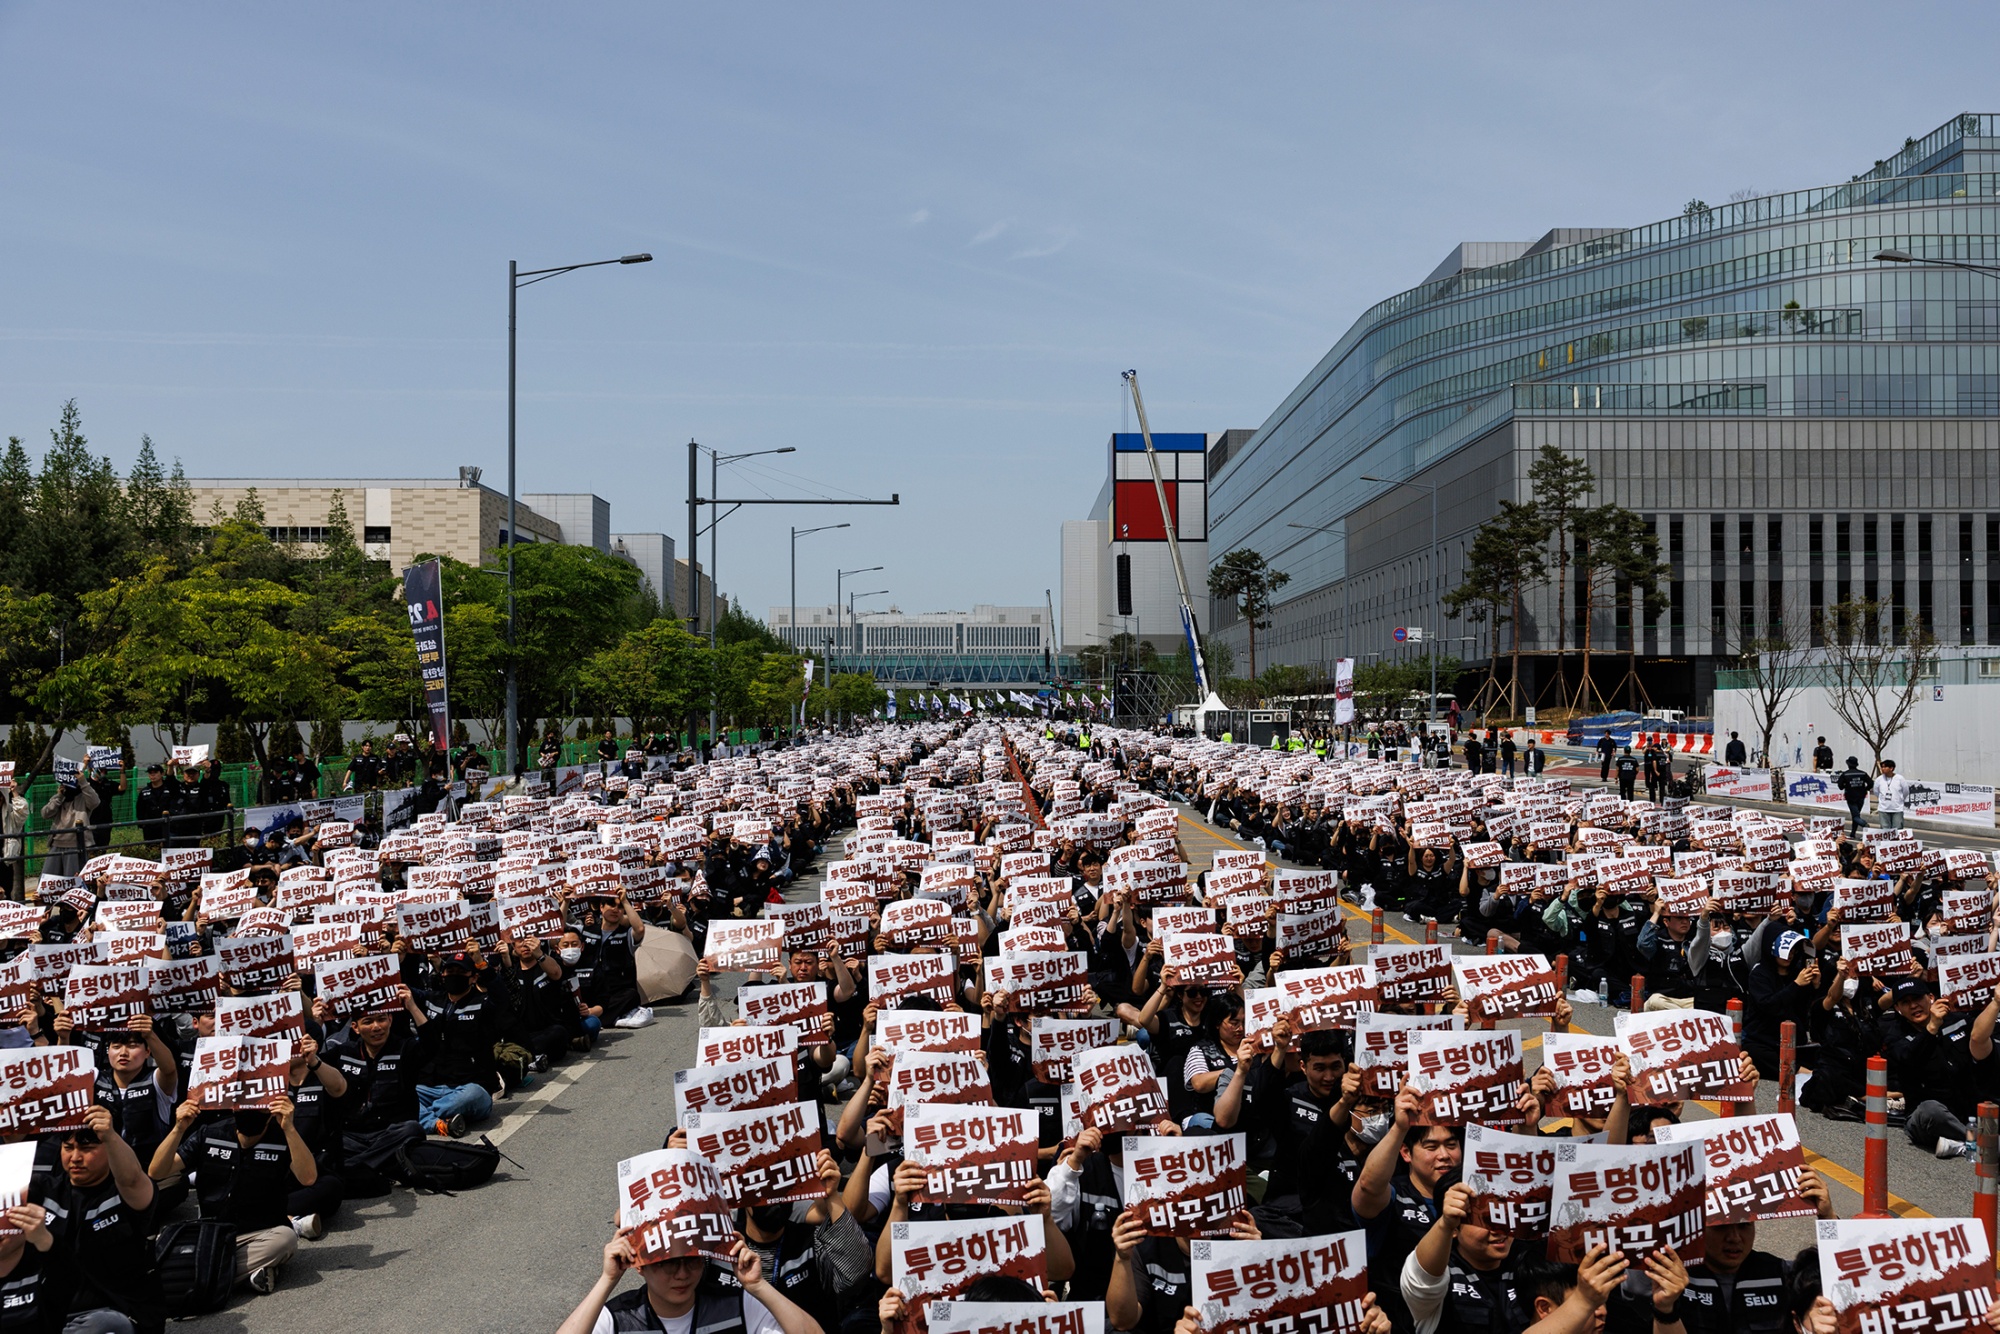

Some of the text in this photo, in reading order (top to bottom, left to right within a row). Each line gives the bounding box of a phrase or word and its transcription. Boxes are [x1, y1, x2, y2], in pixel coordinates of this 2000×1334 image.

[1947, 785, 1959, 793] NSEU
[1589, 803, 1621, 816] 투명하게
[322, 824, 349, 835] 투명하게
[624, 826, 655, 839] 투명하게
[998, 825, 1028, 838] 투명하게
[1533, 825, 1569, 838] 투명하게
[664, 832, 697, 848] 투명하게
[935, 833, 971, 848] 투명하게
[1751, 843, 1786, 856] 투명하게
[1880, 842, 1918, 857] 투명하게
[166, 850, 206, 866] 투명하게
[580, 846, 614, 859] 투명하게
[667, 847, 700, 861] 바꾸고!!!
[1004, 854, 1045, 871] 투명하게
[1113, 847, 1149, 865] 투명하게
[1218, 853, 1259, 869] 투명하게
[1950, 853, 1982, 865] 투명하게
[114, 861, 158, 871] 투명하게
[170, 866, 210, 879] 바꾸고!!!
[338, 862, 374, 878] 투명하게
[570, 863, 615, 880] 투명하게
[831, 862, 872, 879] 투명하게
[1133, 865, 1182, 882] 투명하게
[1601, 860, 1642, 877] 투명하게
[1885, 858, 1921, 872] 바꾸고!!!
[41, 878, 76, 890] 투명하게
[112, 873, 156, 883] 바꾸고!!!
[924, 867, 968, 885] 투명하게
[1209, 872, 1253, 890] 투명하게
[1278, 873, 1332, 894] 투명하게
[1608, 877, 1649, 892] 바꾸고!!!
[1719, 875, 1770, 892] 투명하게
[282, 883, 328, 901] 투명하게
[576, 880, 618, 895] 바꾸고!!!
[825, 884, 871, 900] 투명하게
[1016, 879, 1066, 898] 투명하게
[1138, 884, 1185, 901] 바꾸고!!!
[1661, 880, 1700, 896] 투명하게
[1839, 882, 1888, 901] 투명하게
[206, 890, 251, 907] 투명하게
[1284, 896, 1337, 914] 바꾸고!!!
[1669, 896, 1707, 915] 바꾸고!!!
[1724, 896, 1773, 910] 바꾸고!!!
[1948, 893, 1991, 912] 투명하게
[102, 901, 155, 917] 투명하게
[208, 903, 252, 920] 바꾸고!!!
[403, 903, 461, 929] 투명하게
[503, 900, 554, 922] 투명하게
[887, 904, 944, 923] 투명하게
[1013, 904, 1056, 926] 투명하게
[1845, 903, 1893, 919] 바꾸고!!!
[1158, 911, 1208, 930] 투명하게
[1282, 911, 1336, 939] 투명하게
[293, 926, 351, 949] 투명하게
[412, 927, 469, 950] 바꾸고!!!
[713, 922, 775, 946] 투명하게
[893, 924, 948, 944] 바꾸고!!!
[1004, 930, 1057, 950] 투명하게
[1848, 925, 1903, 951] 투명하게
[219, 938, 284, 964] 투명하게
[1170, 937, 1227, 959] 투명하게
[1289, 933, 1341, 958] 바꾸고!!!
[34, 944, 99, 972] 투명하게
[718, 947, 779, 968] 바꾸고!!!
[1375, 947, 1443, 975] 투명하게
[1857, 949, 1912, 973] 바꾸고!!!
[230, 963, 291, 986] 바꾸고!!!
[322, 958, 390, 990] 투명하게
[876, 957, 944, 985] 투명하게
[1012, 954, 1079, 984] 투명하게
[1179, 962, 1234, 981] 바꾸고!!!
[1463, 957, 1539, 987] 투명하게
[67, 967, 141, 999] 투명하게
[1285, 968, 1366, 998] 투명하게
[1383, 975, 1449, 1001] 바꾸고!!!
[151, 986, 218, 1012] 바꾸고!!!
[334, 984, 398, 1013] 바꾸고!!!
[747, 986, 817, 1019] 투명하게
[1020, 984, 1084, 1008] 바꾸고!!!
[1482, 982, 1556, 1015] 바꾸고!!!
[71, 1001, 145, 1027] 바꾸고!!!
[220, 996, 292, 1031] 투명하게
[1300, 1000, 1375, 1025] 바꾸고!!!
[885, 1016, 969, 1045] 투명하게
[1039, 1022, 1110, 1052] 투명하게
[1628, 1017, 1728, 1058] 투명하게
[199, 1041, 278, 1073] 투명하게
[705, 1030, 785, 1066] 투명하게
[1419, 1034, 1515, 1079] 투명하게
[0, 1050, 80, 1089] 명하게
[342, 1063, 361, 1075] 투쟁
[897, 1060, 981, 1094] 투명하게
[1080, 1054, 1151, 1095] 투명하게
[1649, 1057, 1742, 1095] 바꾸고!!!
[128, 1088, 149, 1099] SELU
[204, 1075, 286, 1103] 바꾸고!!!
[685, 1061, 781, 1113] 투명하게
[297, 1094, 318, 1103] SELU
[1433, 1079, 1521, 1118] 바꾸고!!!
[1093, 1091, 1167, 1129] 바꾸고!!!
[697, 1107, 804, 1163] 투명하게
[914, 1113, 1023, 1154] 투명하게
[1705, 1119, 1784, 1168] 명하게
[208, 1147, 231, 1160] 투쟁
[254, 1153, 278, 1162] SELU
[1134, 1138, 1236, 1187] 투명하게
[629, 1161, 722, 1210] 투명하게
[719, 1152, 819, 1201] 바꾸고!!!
[927, 1159, 1033, 1198] 바꾸고!!!
[1568, 1146, 1695, 1208] 투명하게
[1706, 1165, 1802, 1216] 바꾸고!!!
[1149, 1185, 1245, 1231] 바꾸고!!!
[1402, 1209, 1430, 1223] 투쟁
[92, 1215, 119, 1231] SELU
[644, 1213, 734, 1253] 바꾸고!!!
[1584, 1206, 1703, 1260] 바꾸고!!!
[904, 1221, 1029, 1281] 투명하게
[1834, 1223, 1972, 1288] 투명하게
[786, 1271, 809, 1288] SELU
[1206, 1238, 1349, 1306] 투명하게
[1152, 1279, 1177, 1295] 투쟁
[1452, 1283, 1482, 1299] 투쟁
[1683, 1289, 1713, 1305] 투쟁
[3, 1294, 34, 1308] SELU
[1745, 1297, 1777, 1307] SELU
[1859, 1287, 1990, 1334] 바꾸고!!!
